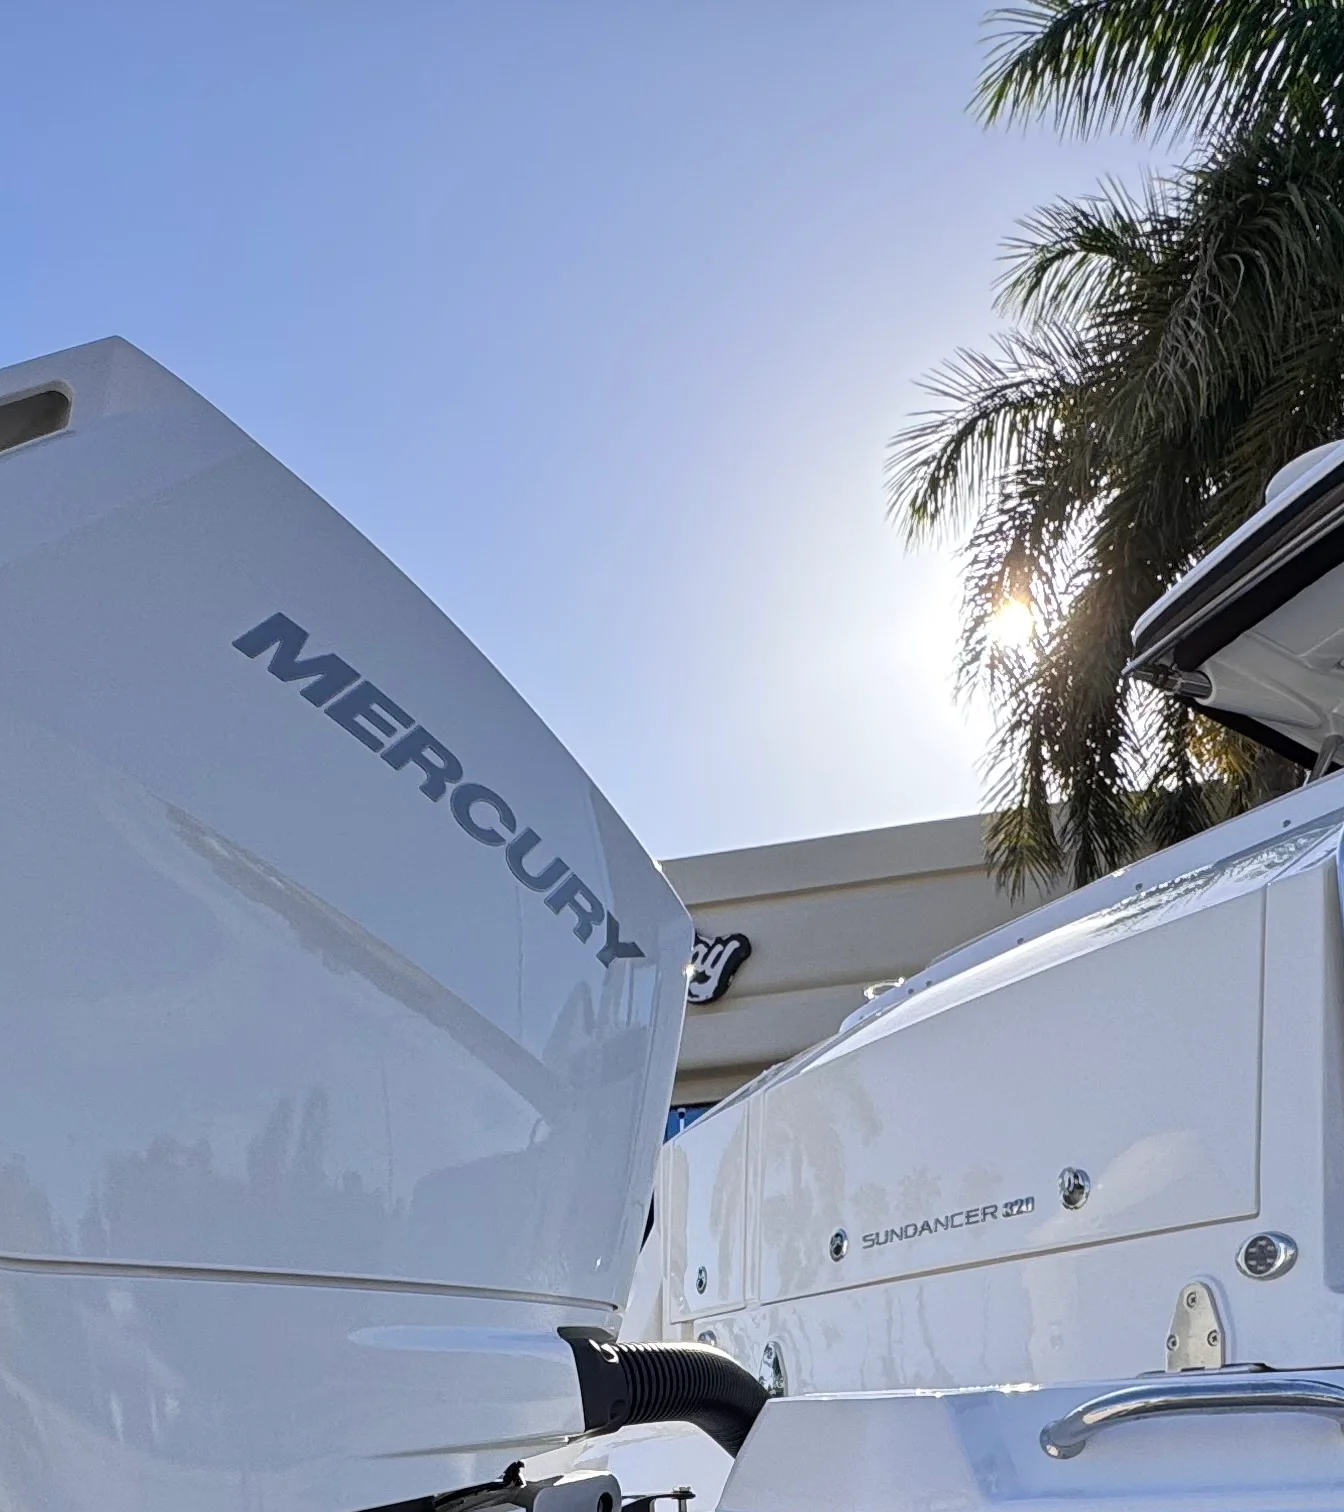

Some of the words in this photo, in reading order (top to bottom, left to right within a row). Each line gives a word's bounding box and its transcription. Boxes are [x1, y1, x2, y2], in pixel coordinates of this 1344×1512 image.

[232, 612, 646, 968] MERCURY
[862, 1204, 999, 1249] SUNDANCER
[1001, 1196, 1036, 1218] 320
